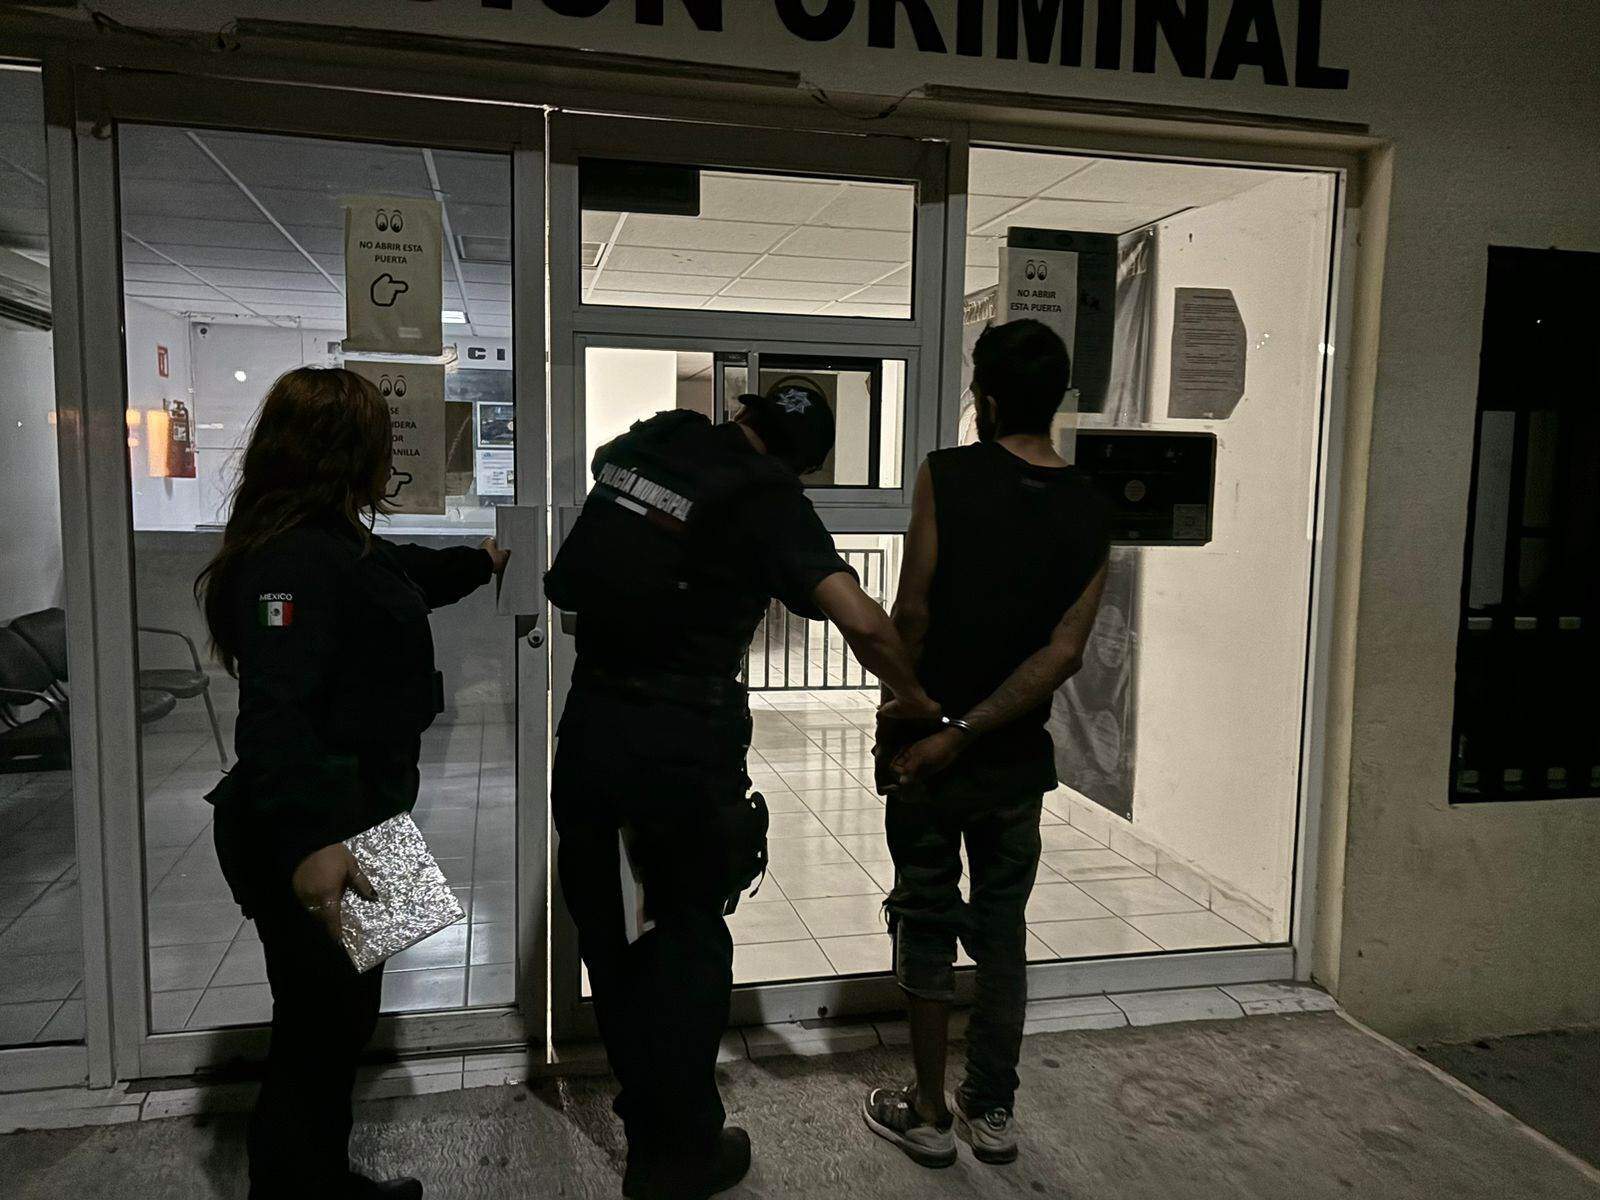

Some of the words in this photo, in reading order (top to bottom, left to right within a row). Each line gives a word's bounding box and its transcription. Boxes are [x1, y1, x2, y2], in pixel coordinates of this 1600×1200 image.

[359, 241, 373, 249] NO
[375, 242, 400, 251] ABRIR
[403, 244, 423, 252] ESTA
[375, 255, 407, 264] PUERTA
[1017, 289, 1030, 298] NO
[1032, 290, 1056, 299] ABRIR
[1010, 303, 1029, 311] ESTA
[1031, 303, 1062, 312] PUERTA
[392, 421, 417, 429] DERA
[392, 434, 404, 442] OR
[392, 448, 420, 456] ANILLA
[629, 476, 694, 522] MUNICIPAL
[259, 593, 293, 601] MEXICO
